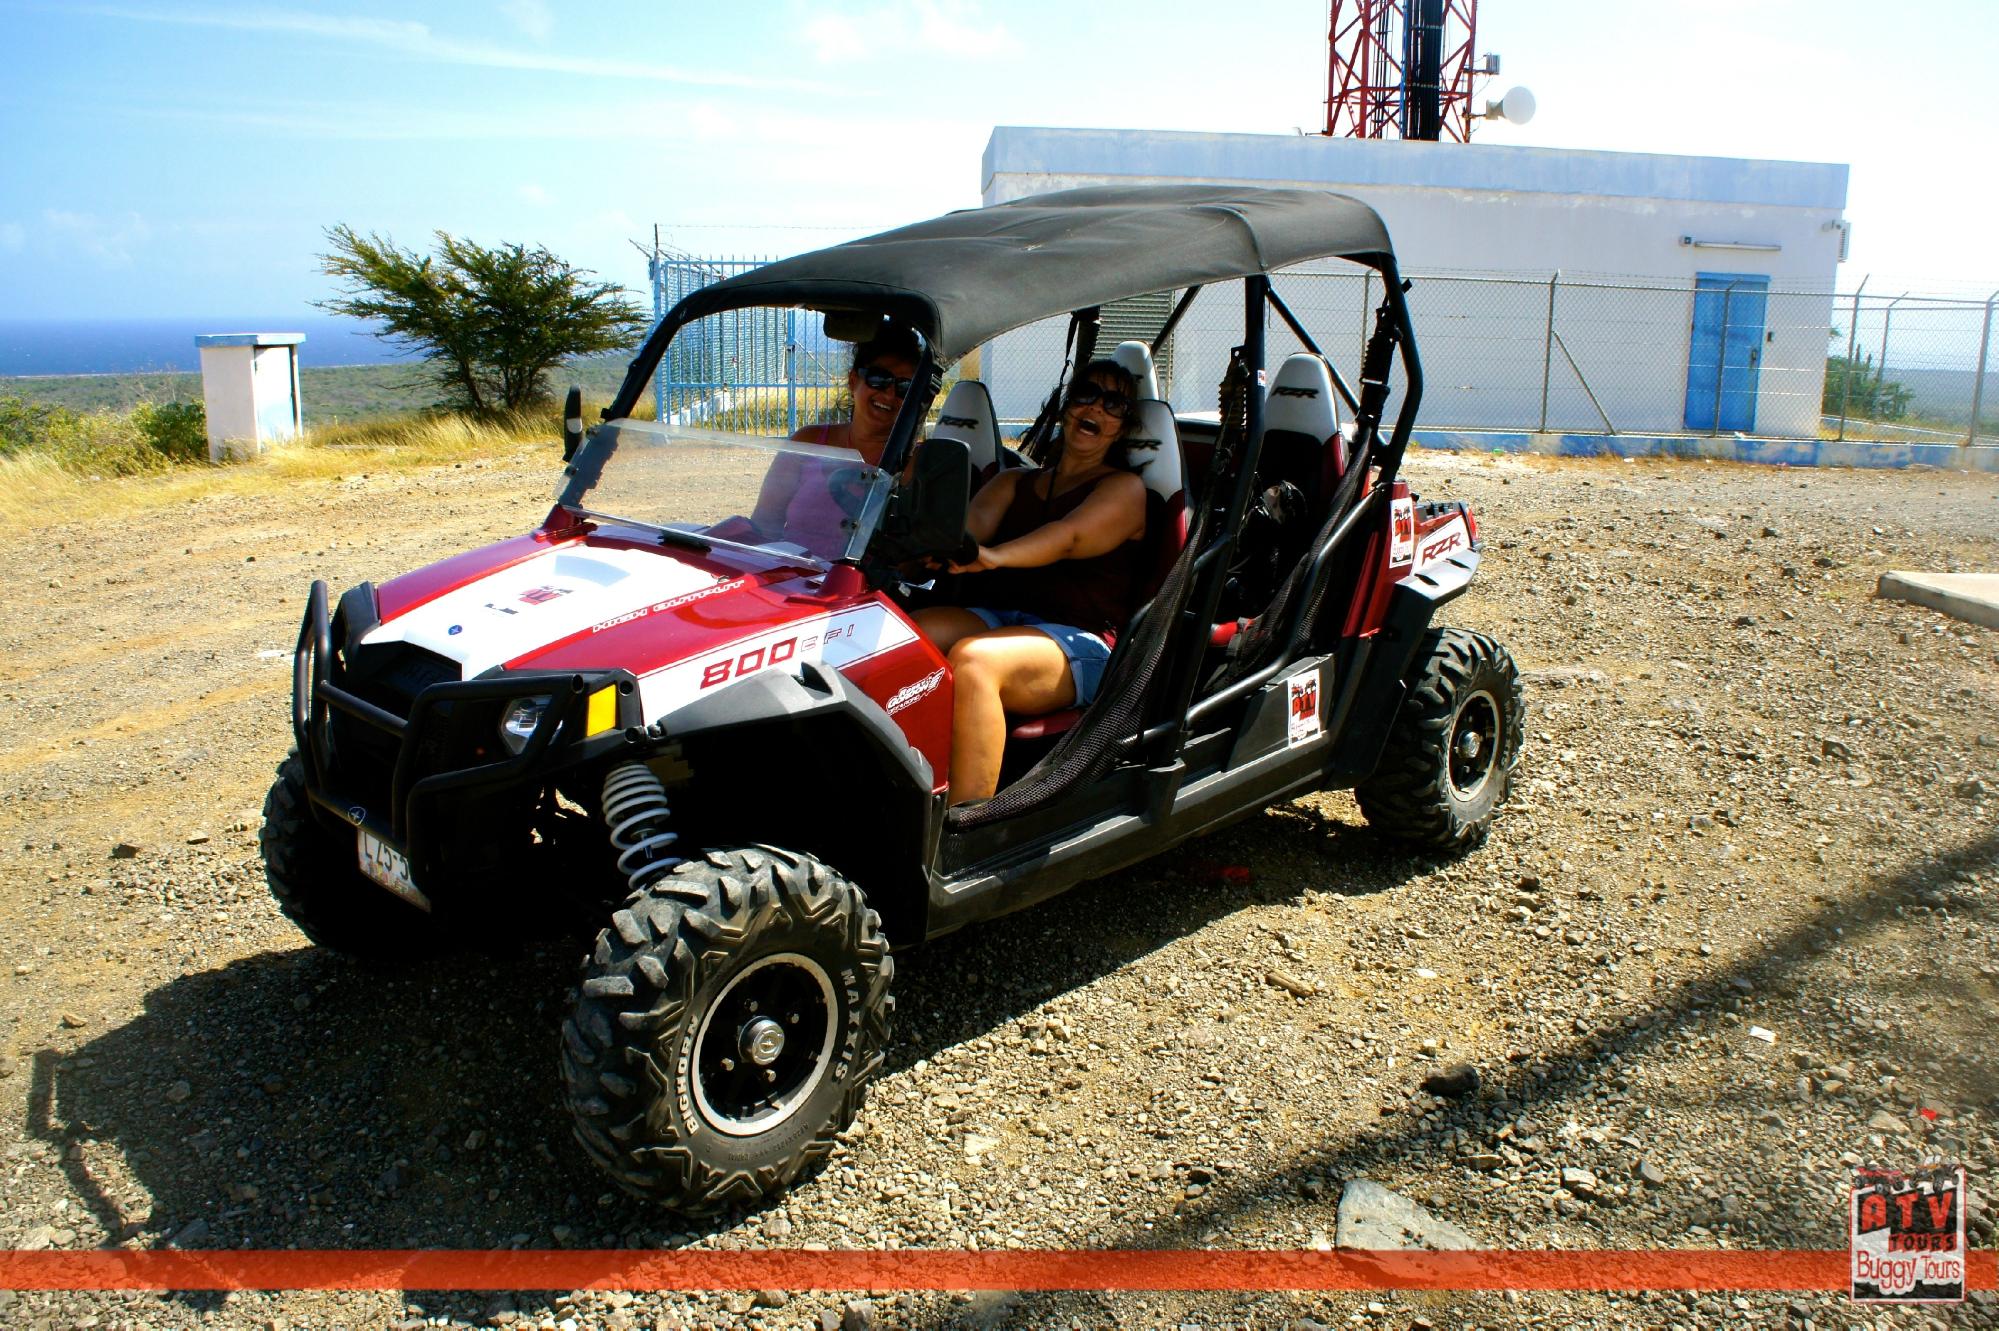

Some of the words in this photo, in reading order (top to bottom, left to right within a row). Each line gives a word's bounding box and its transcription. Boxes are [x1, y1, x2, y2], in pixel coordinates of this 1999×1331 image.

[1422, 532, 1461, 566] RZR
[700, 637, 798, 689] 800
[835, 968, 861, 1081] MAXXIS
[677, 1015, 700, 1135] BIGHORN
